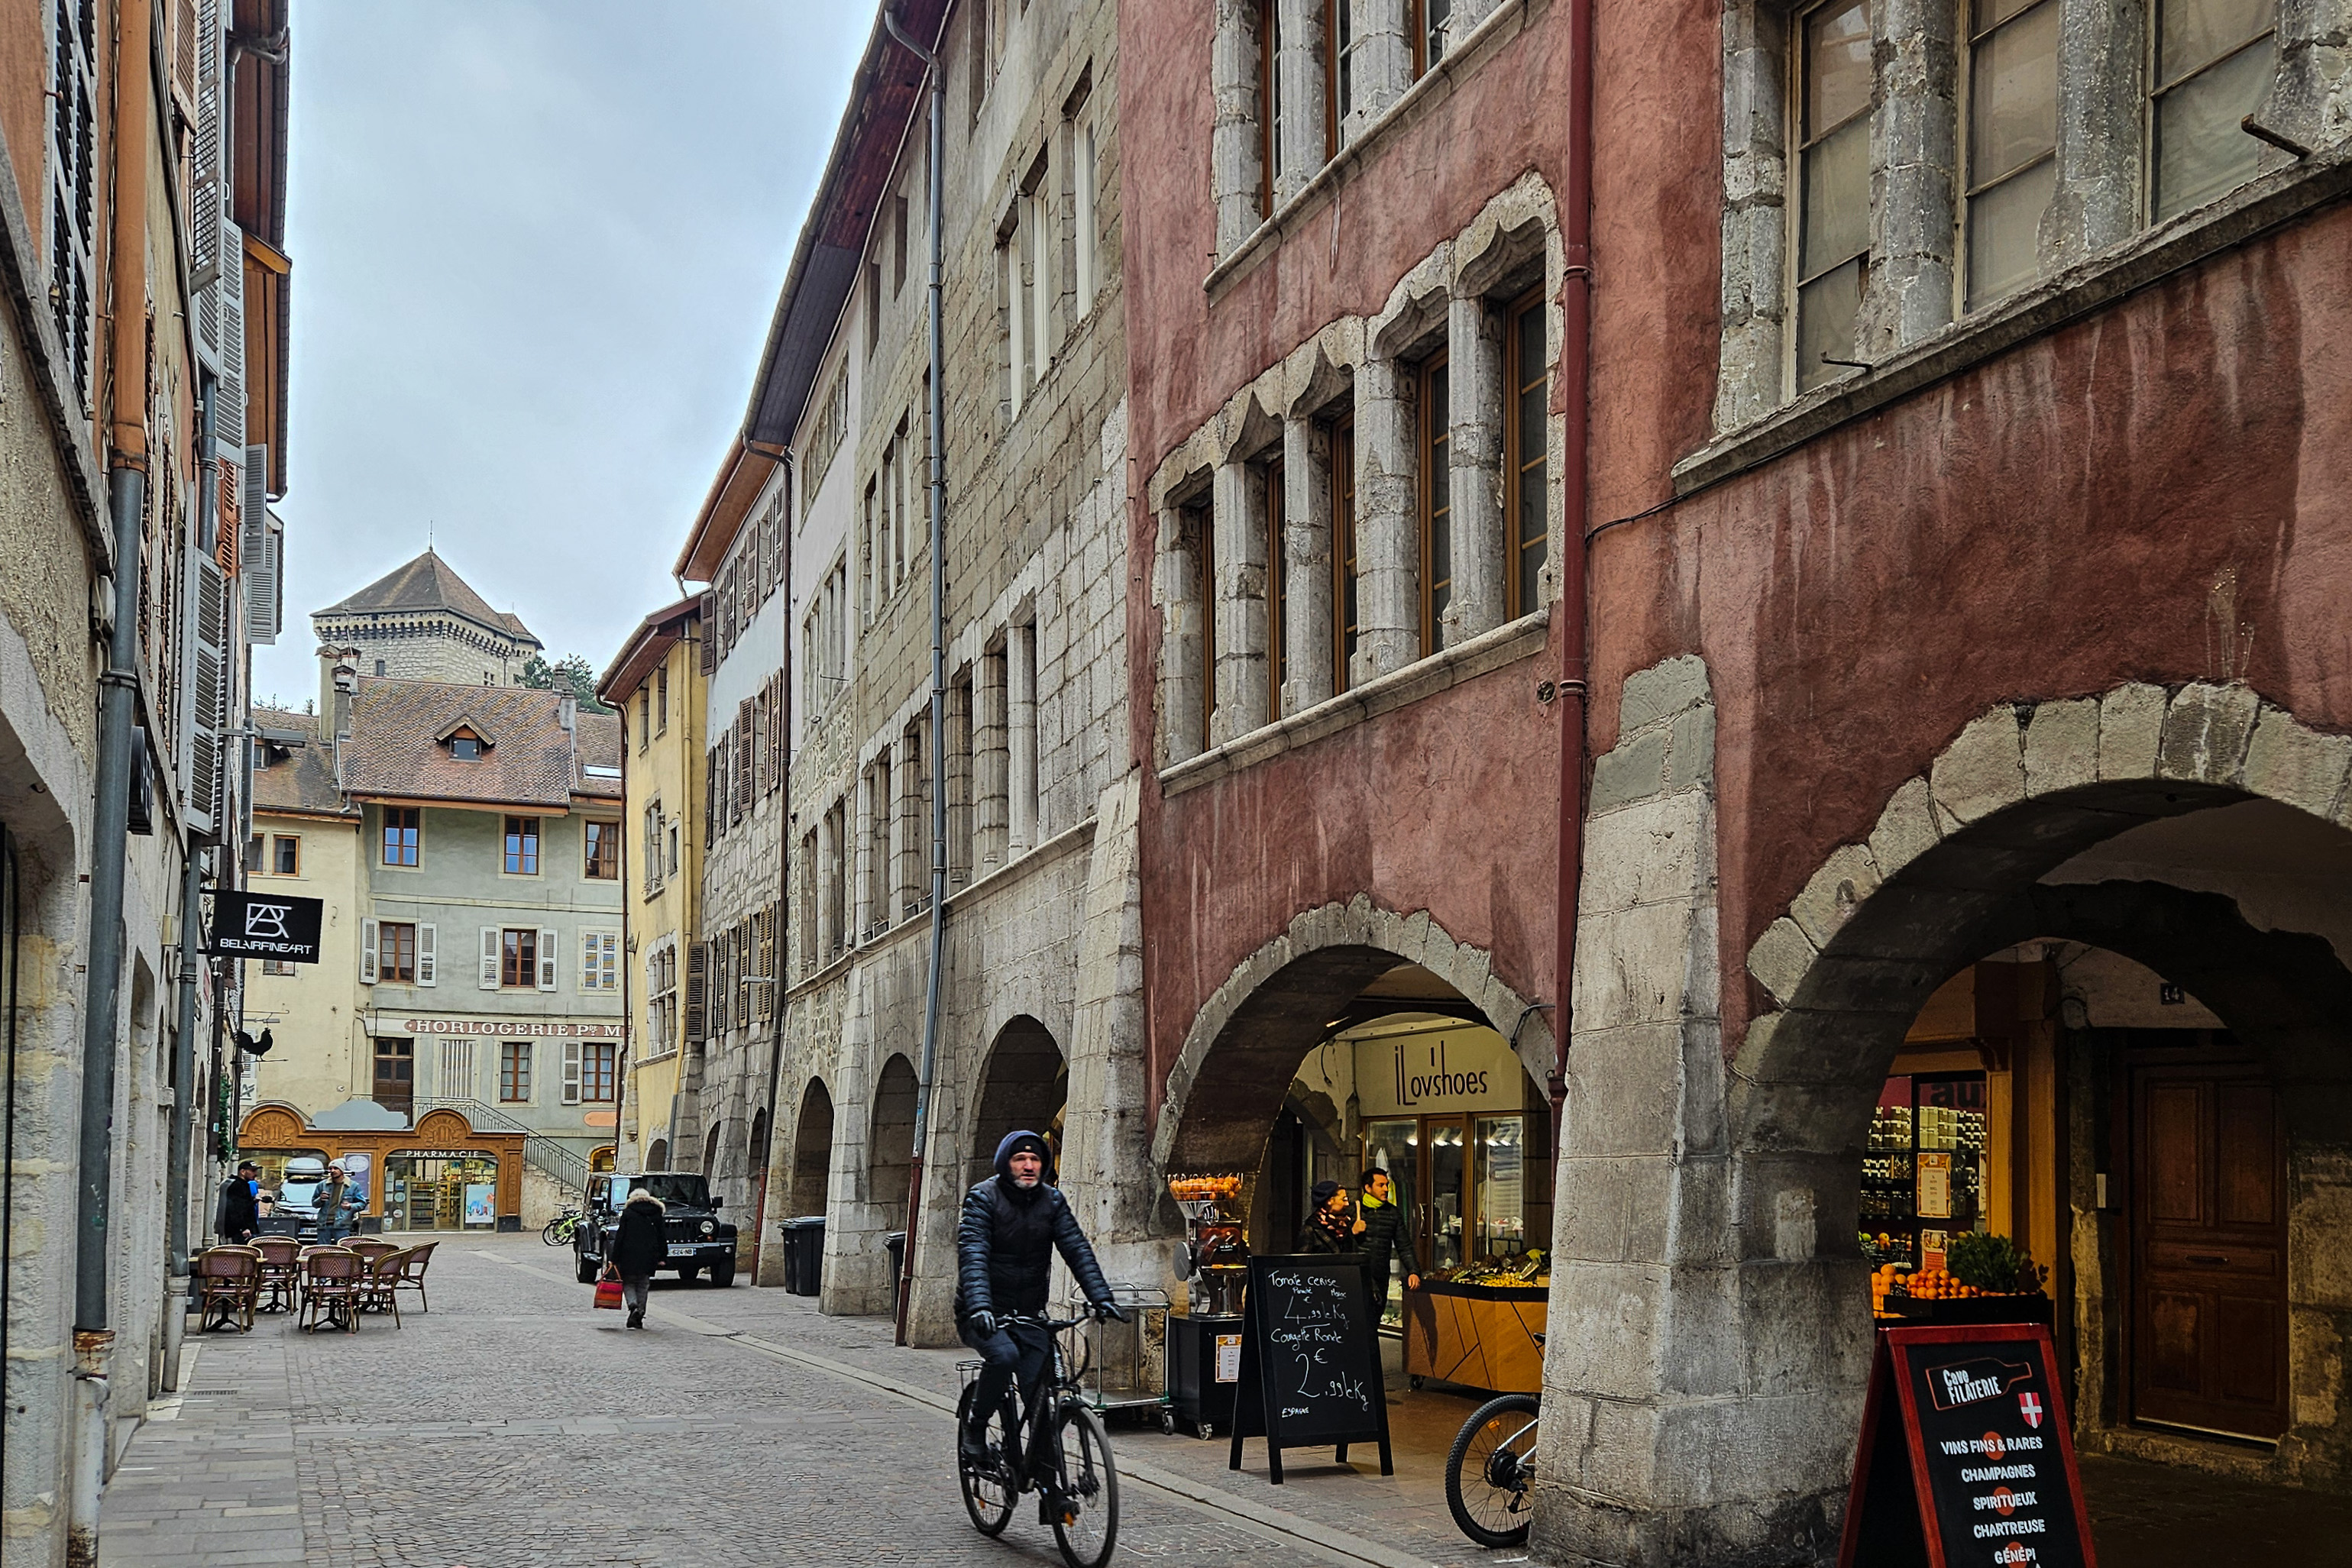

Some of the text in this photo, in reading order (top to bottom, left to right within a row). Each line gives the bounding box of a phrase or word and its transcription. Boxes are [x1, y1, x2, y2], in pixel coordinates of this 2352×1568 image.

[416, 1020, 568, 1036] HORLOGERIE
[1930, 1082, 1986, 1107] au
[1268, 1270, 1302, 1288] Tomate
[1315, 1328, 1344, 1343] Ronde
[1314, 1348, 1328, 1364] €
[1943, 1369, 1970, 1387] Cave
[1948, 1376, 2002, 1405] FILATERIE
[1940, 1436, 2043, 1455] VINS FINS & RARES
[1961, 1463, 2037, 1482] CHAMPAGNES
[1972, 1491, 2038, 1511] SPIRITUEUX
[1973, 1518, 2046, 1539] CHARTREUSE
[1994, 1546, 2037, 1564] GÉNÉPI
